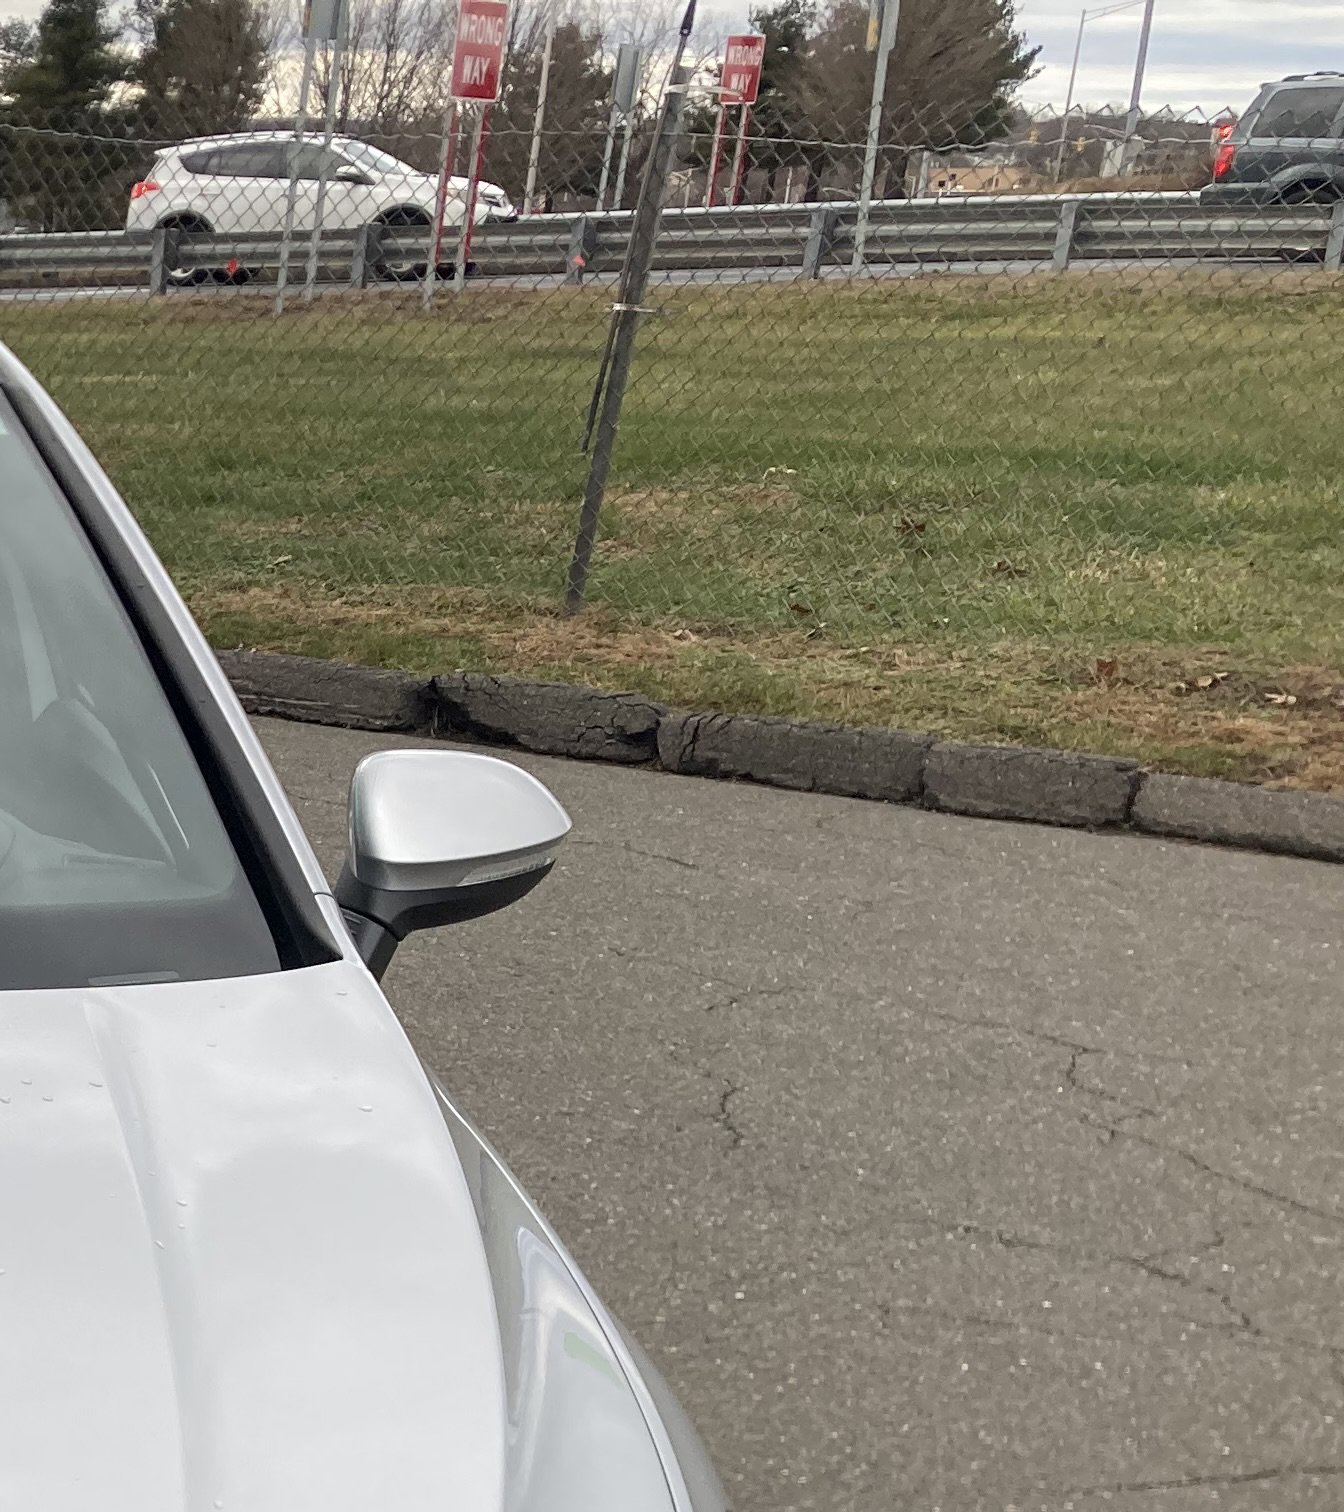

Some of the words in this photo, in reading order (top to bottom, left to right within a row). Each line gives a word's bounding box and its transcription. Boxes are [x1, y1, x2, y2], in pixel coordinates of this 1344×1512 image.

[459, 12, 504, 46] WRONG
[727, 45, 762, 66] WRONG
[462, 54, 491, 86] WAY
[730, 72, 753, 93] WAY
